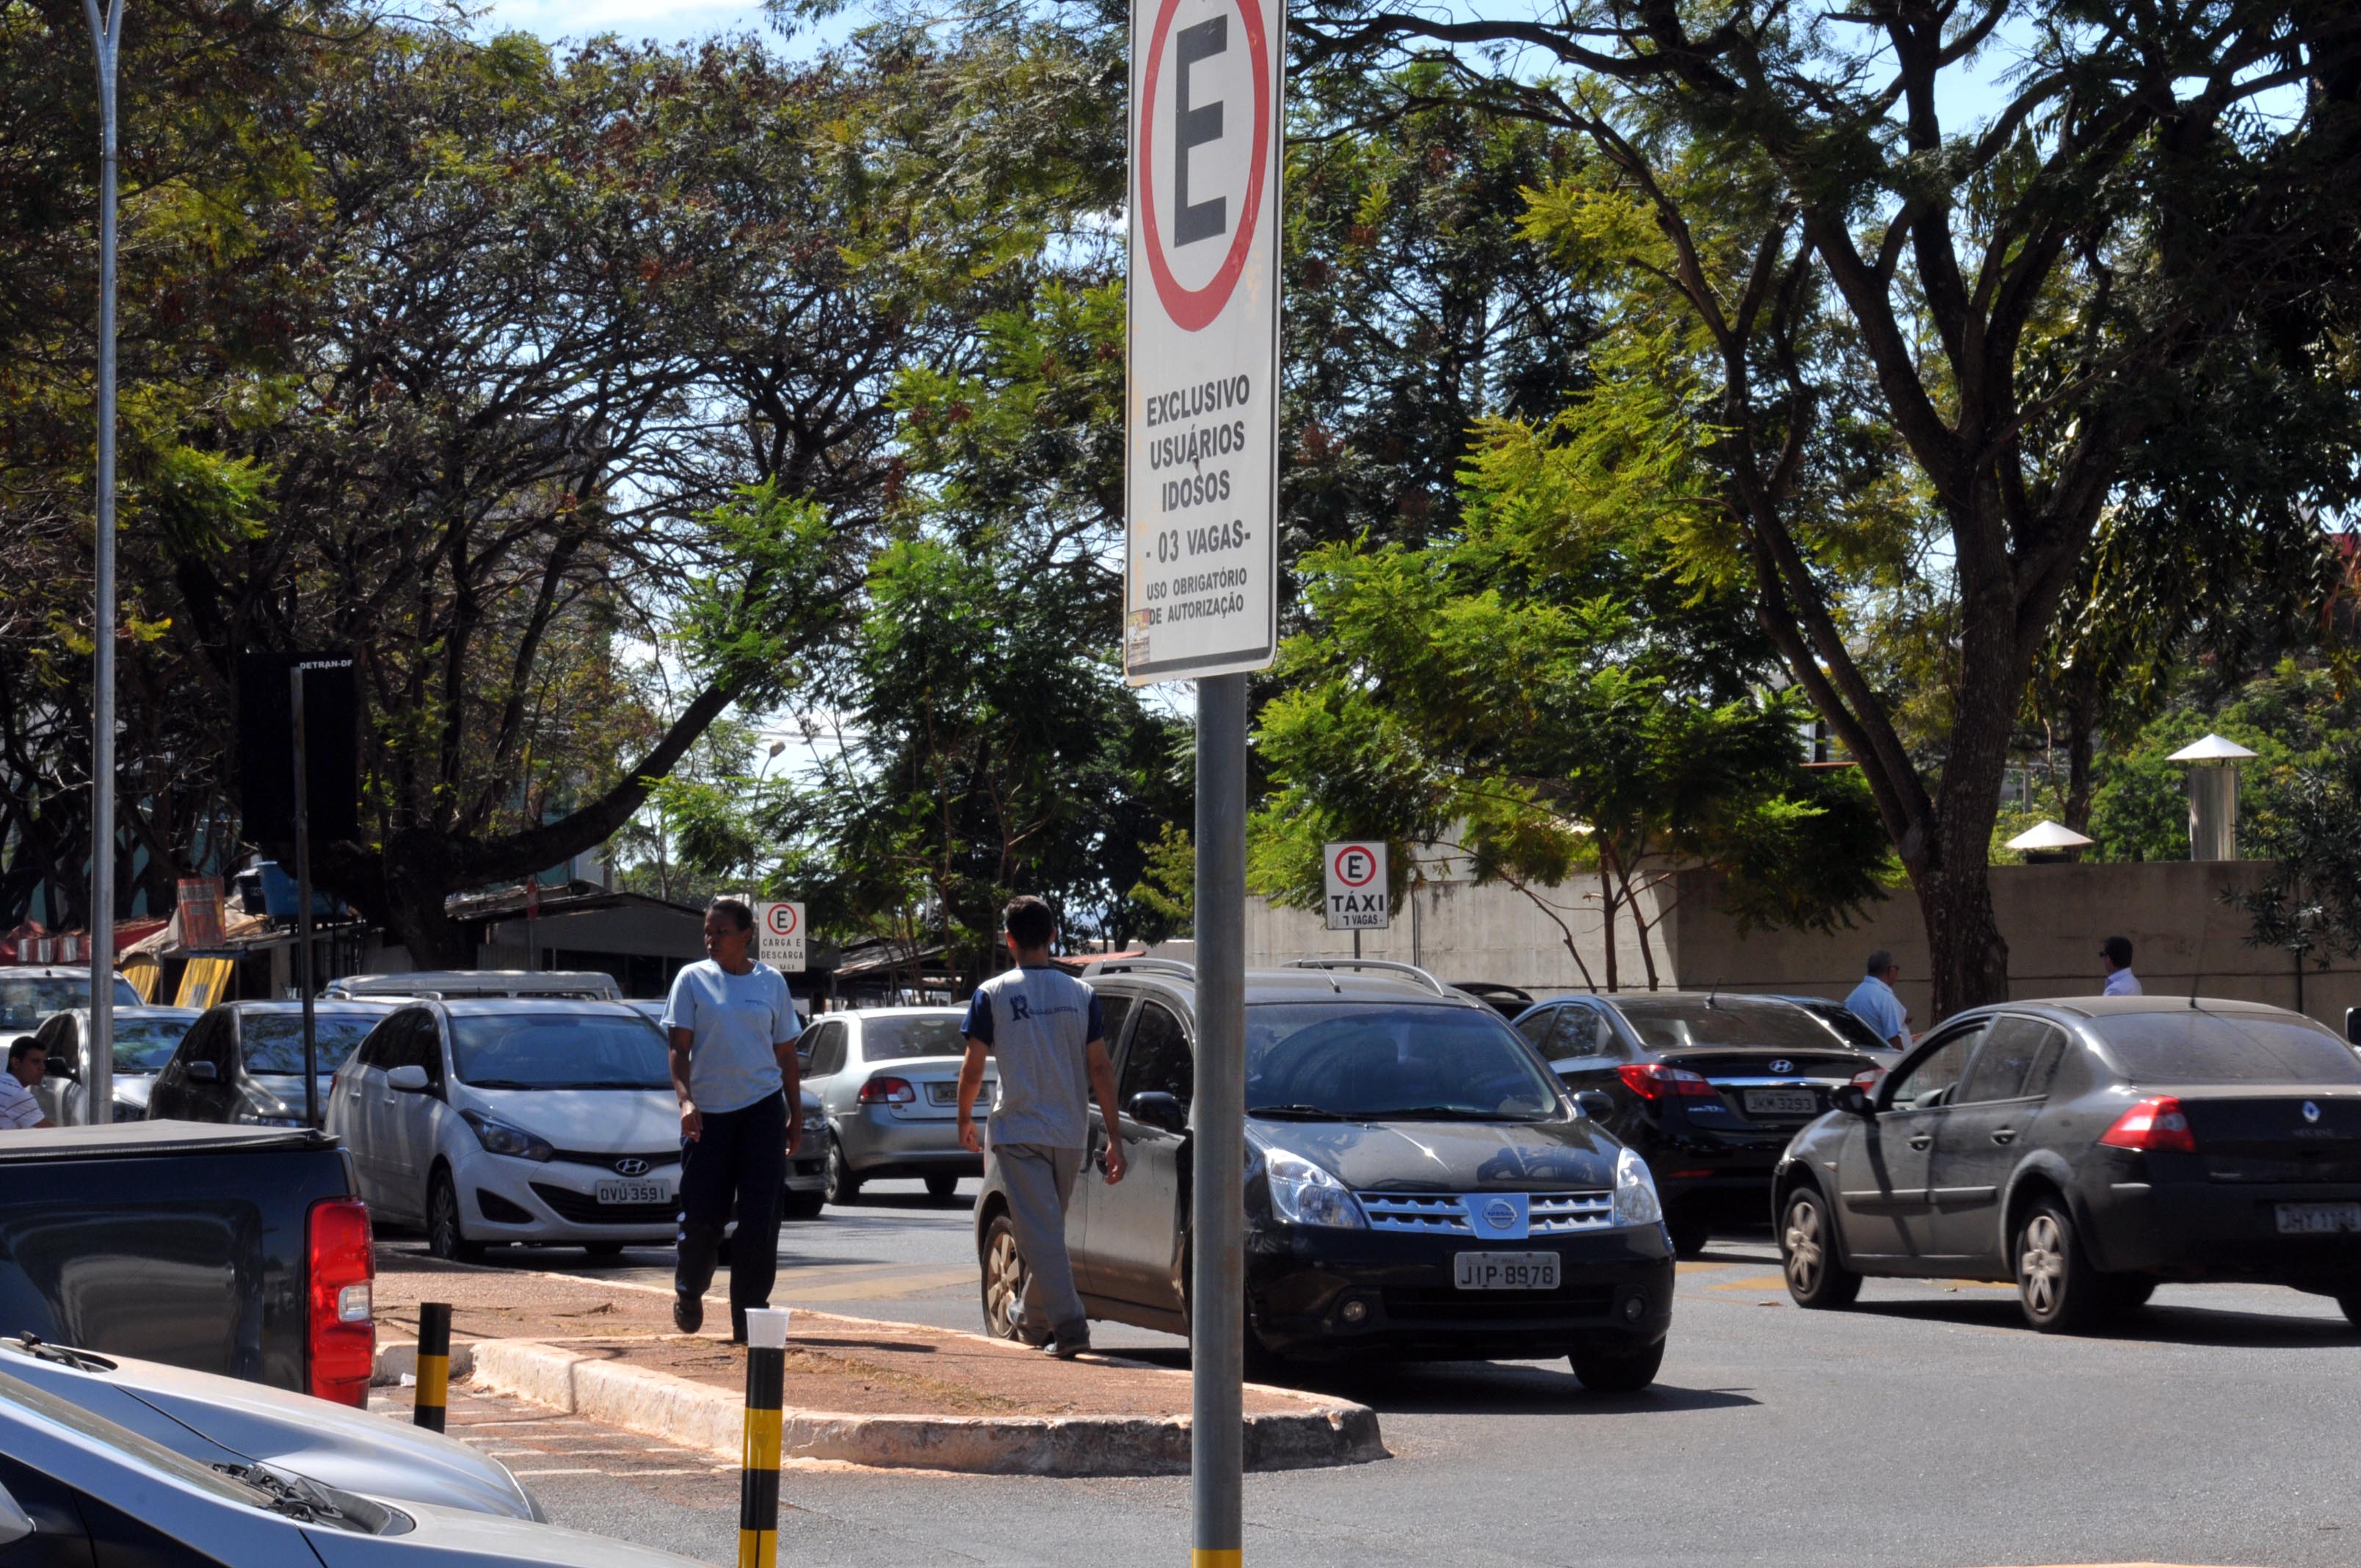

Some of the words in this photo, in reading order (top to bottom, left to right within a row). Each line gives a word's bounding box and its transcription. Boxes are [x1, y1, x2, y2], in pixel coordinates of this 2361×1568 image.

[1175, 14, 1227, 248] E
[1147, 374, 1250, 428] EXCLUSIVO
[1150, 421, 1245, 471] USUÁRIOS
[1162, 470, 1230, 512] IDOSOS
[1158, 529, 1179, 564] 03
[1146, 581, 1167, 601] USO
[1172, 567, 1247, 596] OBRIGATÓRIO
[1149, 607, 1162, 625] DE
[1167, 592, 1244, 623] AUTORIZAÇÃO
[299, 659, 353, 669] DETRAN-DF
[1348, 855, 1363, 879] E
[1330, 890, 1384, 912] TÁXI
[777, 911, 788, 929] E
[1352, 914, 1378, 925] VAGAS
[761, 951, 804, 959] DESCARGA
[762, 938, 791, 947] CARGA
[796, 938, 801, 947] E
